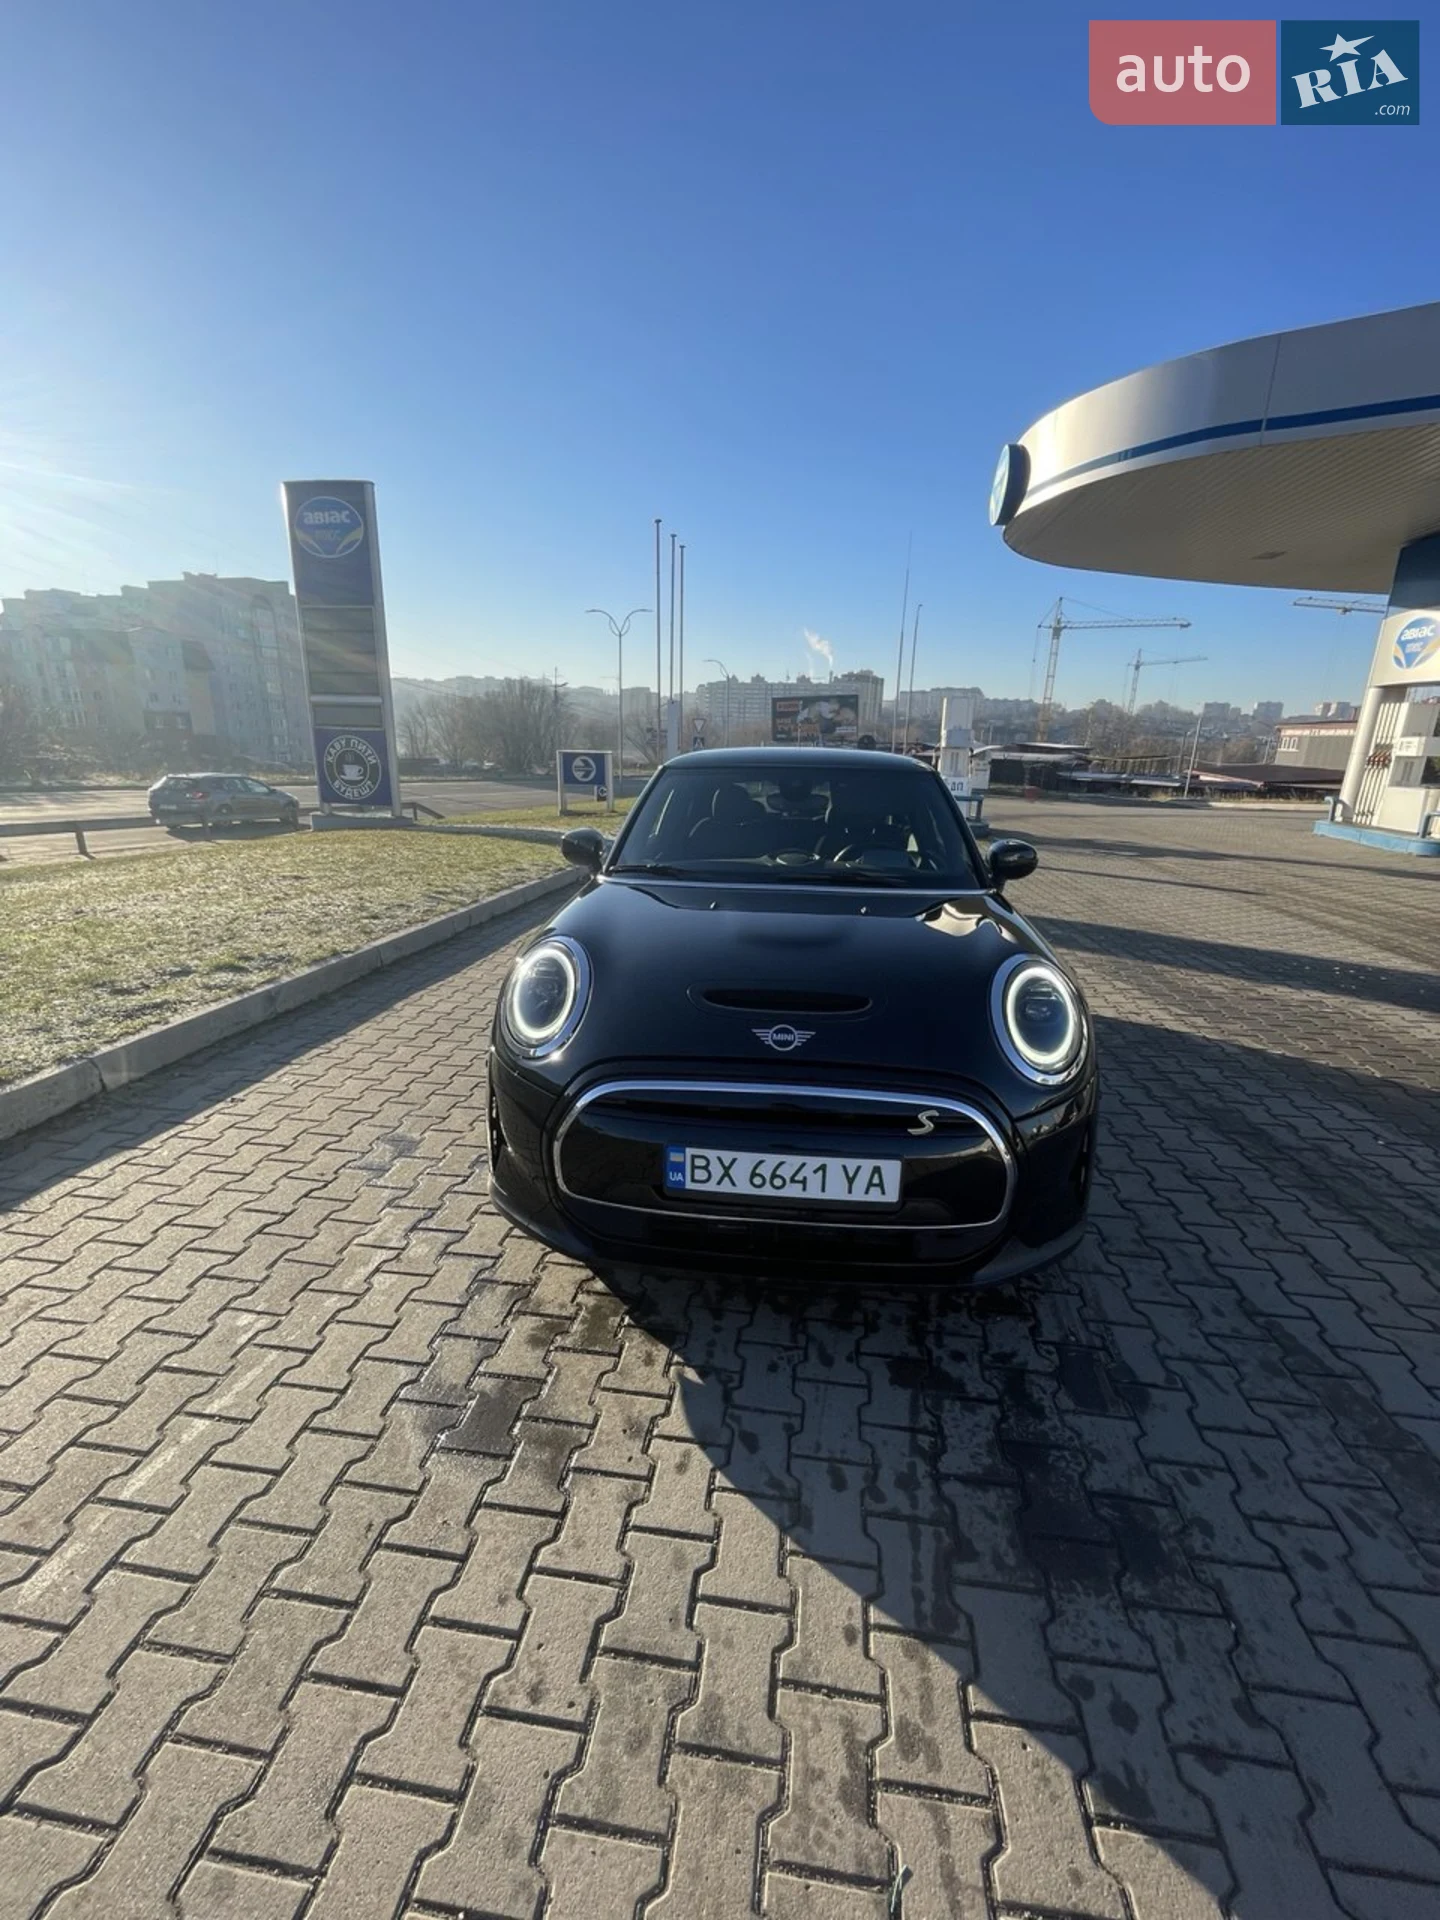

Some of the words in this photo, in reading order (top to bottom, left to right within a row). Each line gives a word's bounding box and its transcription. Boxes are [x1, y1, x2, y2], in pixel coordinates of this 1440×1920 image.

[772, 1032, 794, 1042] MINI
[906, 1109, 940, 1136] S
[669, 1172, 684, 1182] UA
[690, 1154, 738, 1187] BX
[749, 1159, 828, 1193] 6641
[841, 1164, 886, 1196] YA
